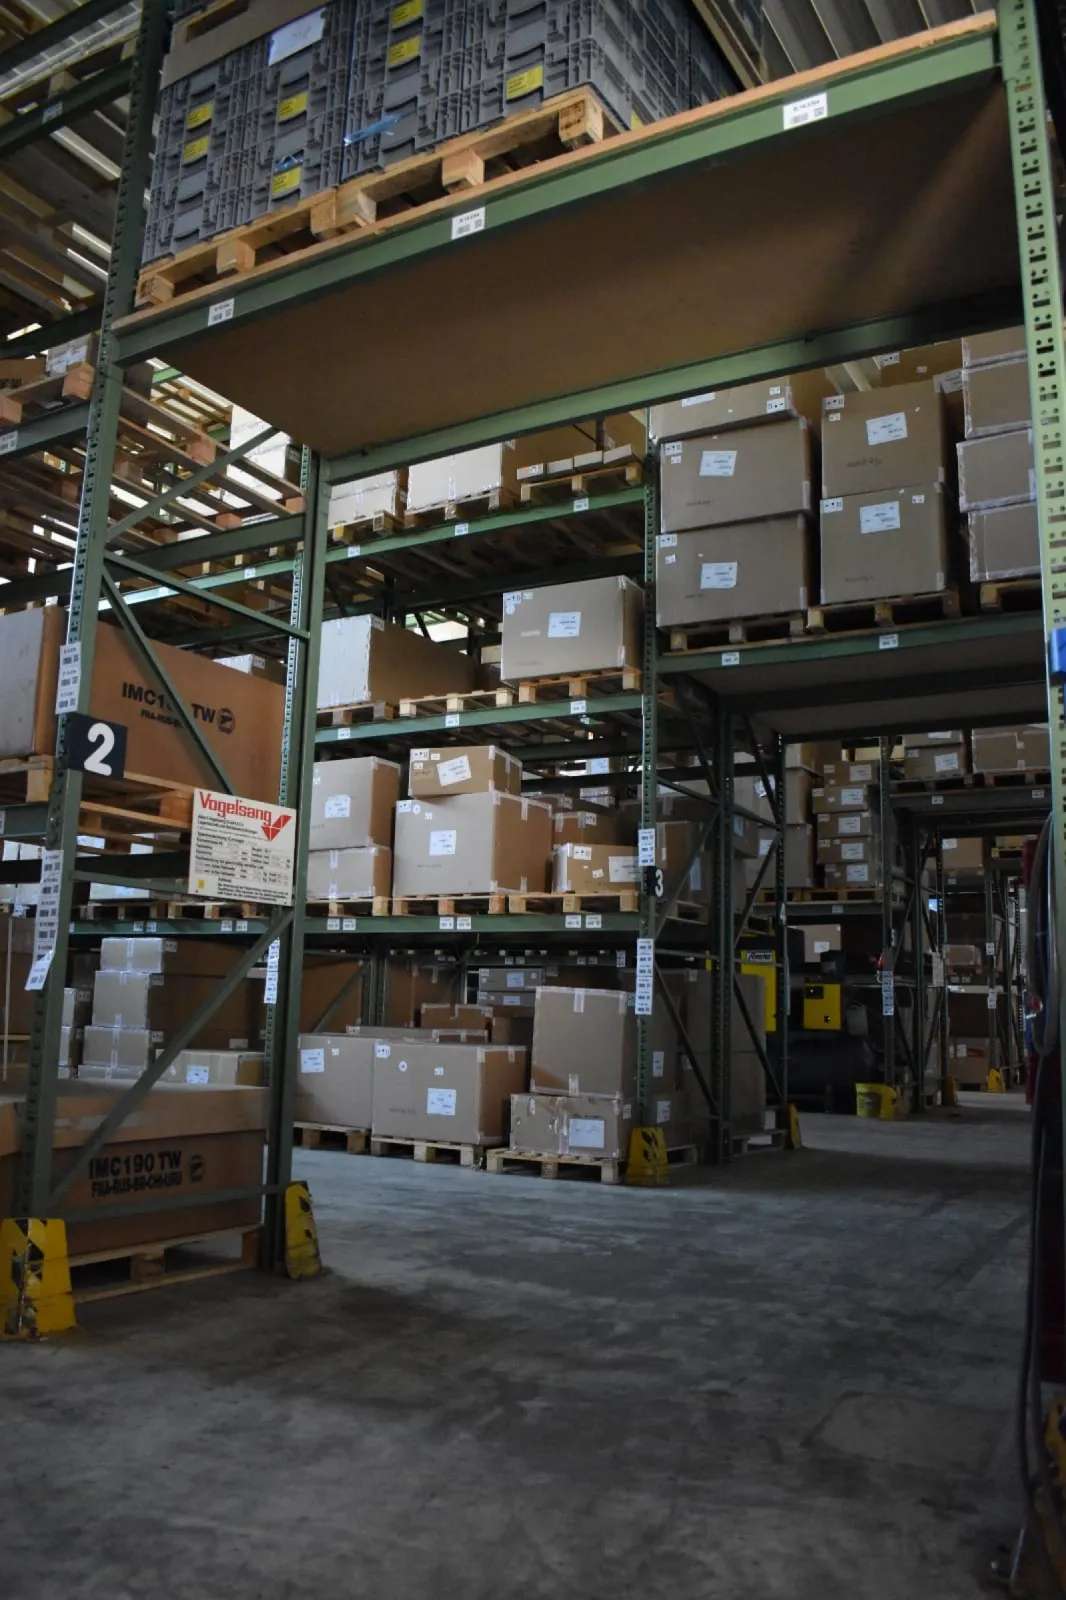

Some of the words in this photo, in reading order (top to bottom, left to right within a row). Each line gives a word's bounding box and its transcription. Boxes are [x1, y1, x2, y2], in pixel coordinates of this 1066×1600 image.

[191, 703, 216, 723] TW
[84, 722, 115, 776] 2
[199, 791, 272, 826] Vogelsang
[655, 868, 663, 898] 3
[89, 1154, 155, 1179] IMC190
[158, 1150, 182, 1170] TW
